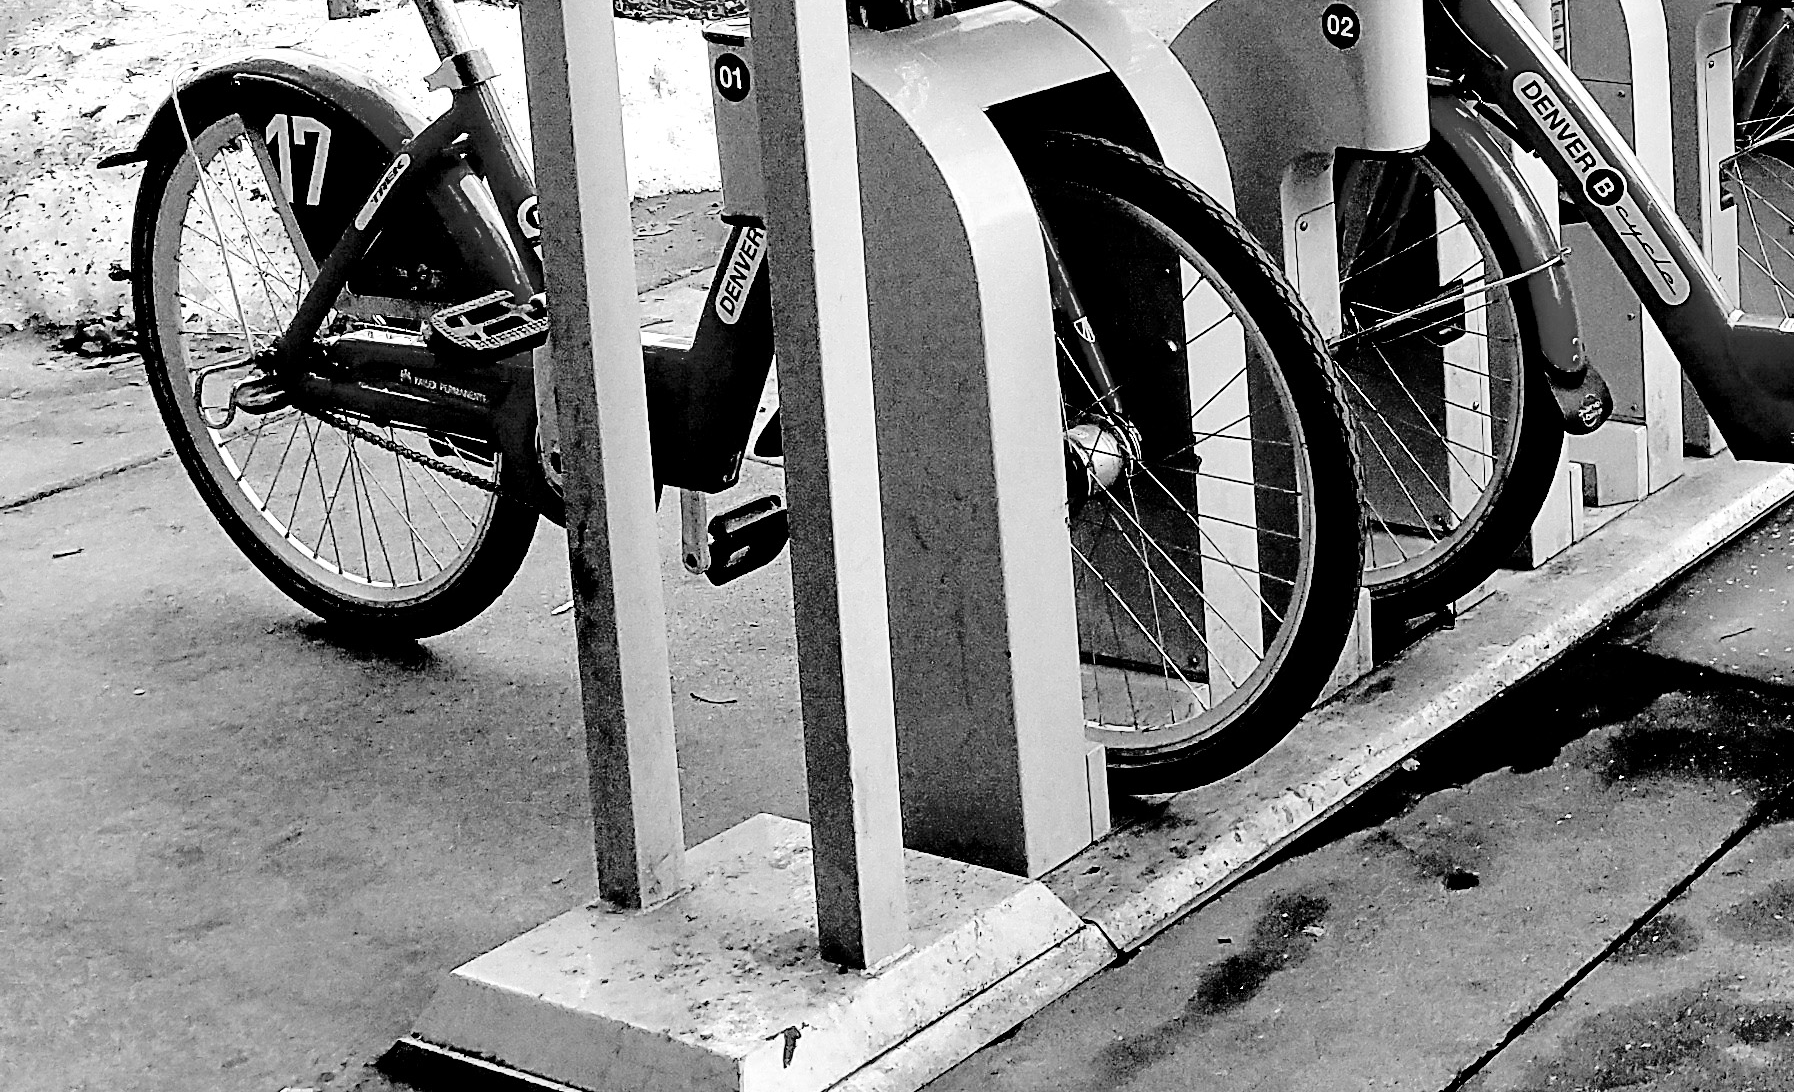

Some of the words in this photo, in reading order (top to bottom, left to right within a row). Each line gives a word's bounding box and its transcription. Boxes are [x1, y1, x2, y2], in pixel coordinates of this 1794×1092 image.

[1326, 13, 1354, 38] 02
[718, 64, 743, 90] 01
[265, 113, 332, 206] 17
[1520, 79, 1597, 173] DENVER
[369, 160, 405, 205] TREK
[719, 227, 766, 318] DENVER
